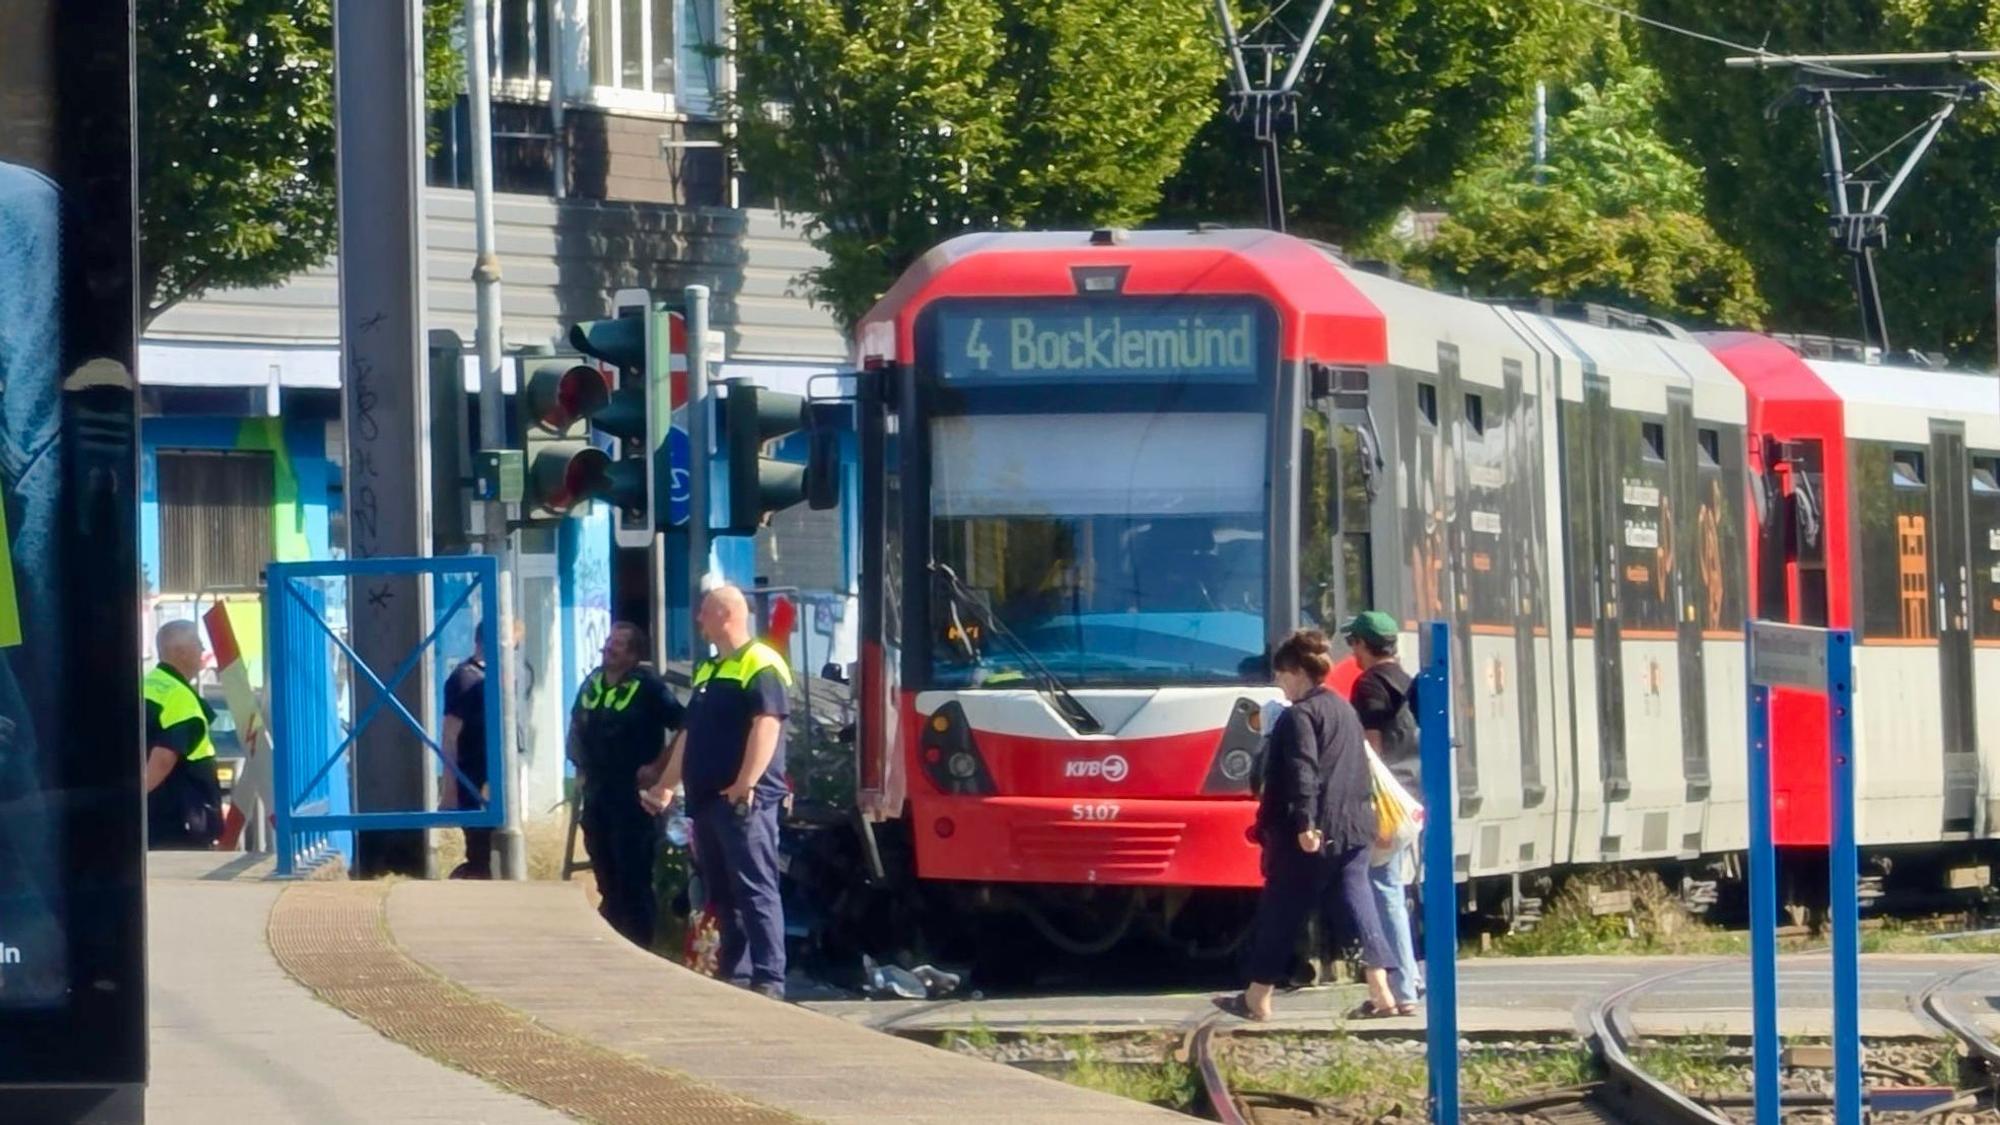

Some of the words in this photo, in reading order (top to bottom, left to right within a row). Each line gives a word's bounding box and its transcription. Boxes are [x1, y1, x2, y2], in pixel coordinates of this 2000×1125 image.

[966, 317, 992, 370] 4
[1010, 315, 1250, 370] Bocklemünd
[1065, 761, 1101, 777] KVB
[1072, 804, 1120, 820] 5107
